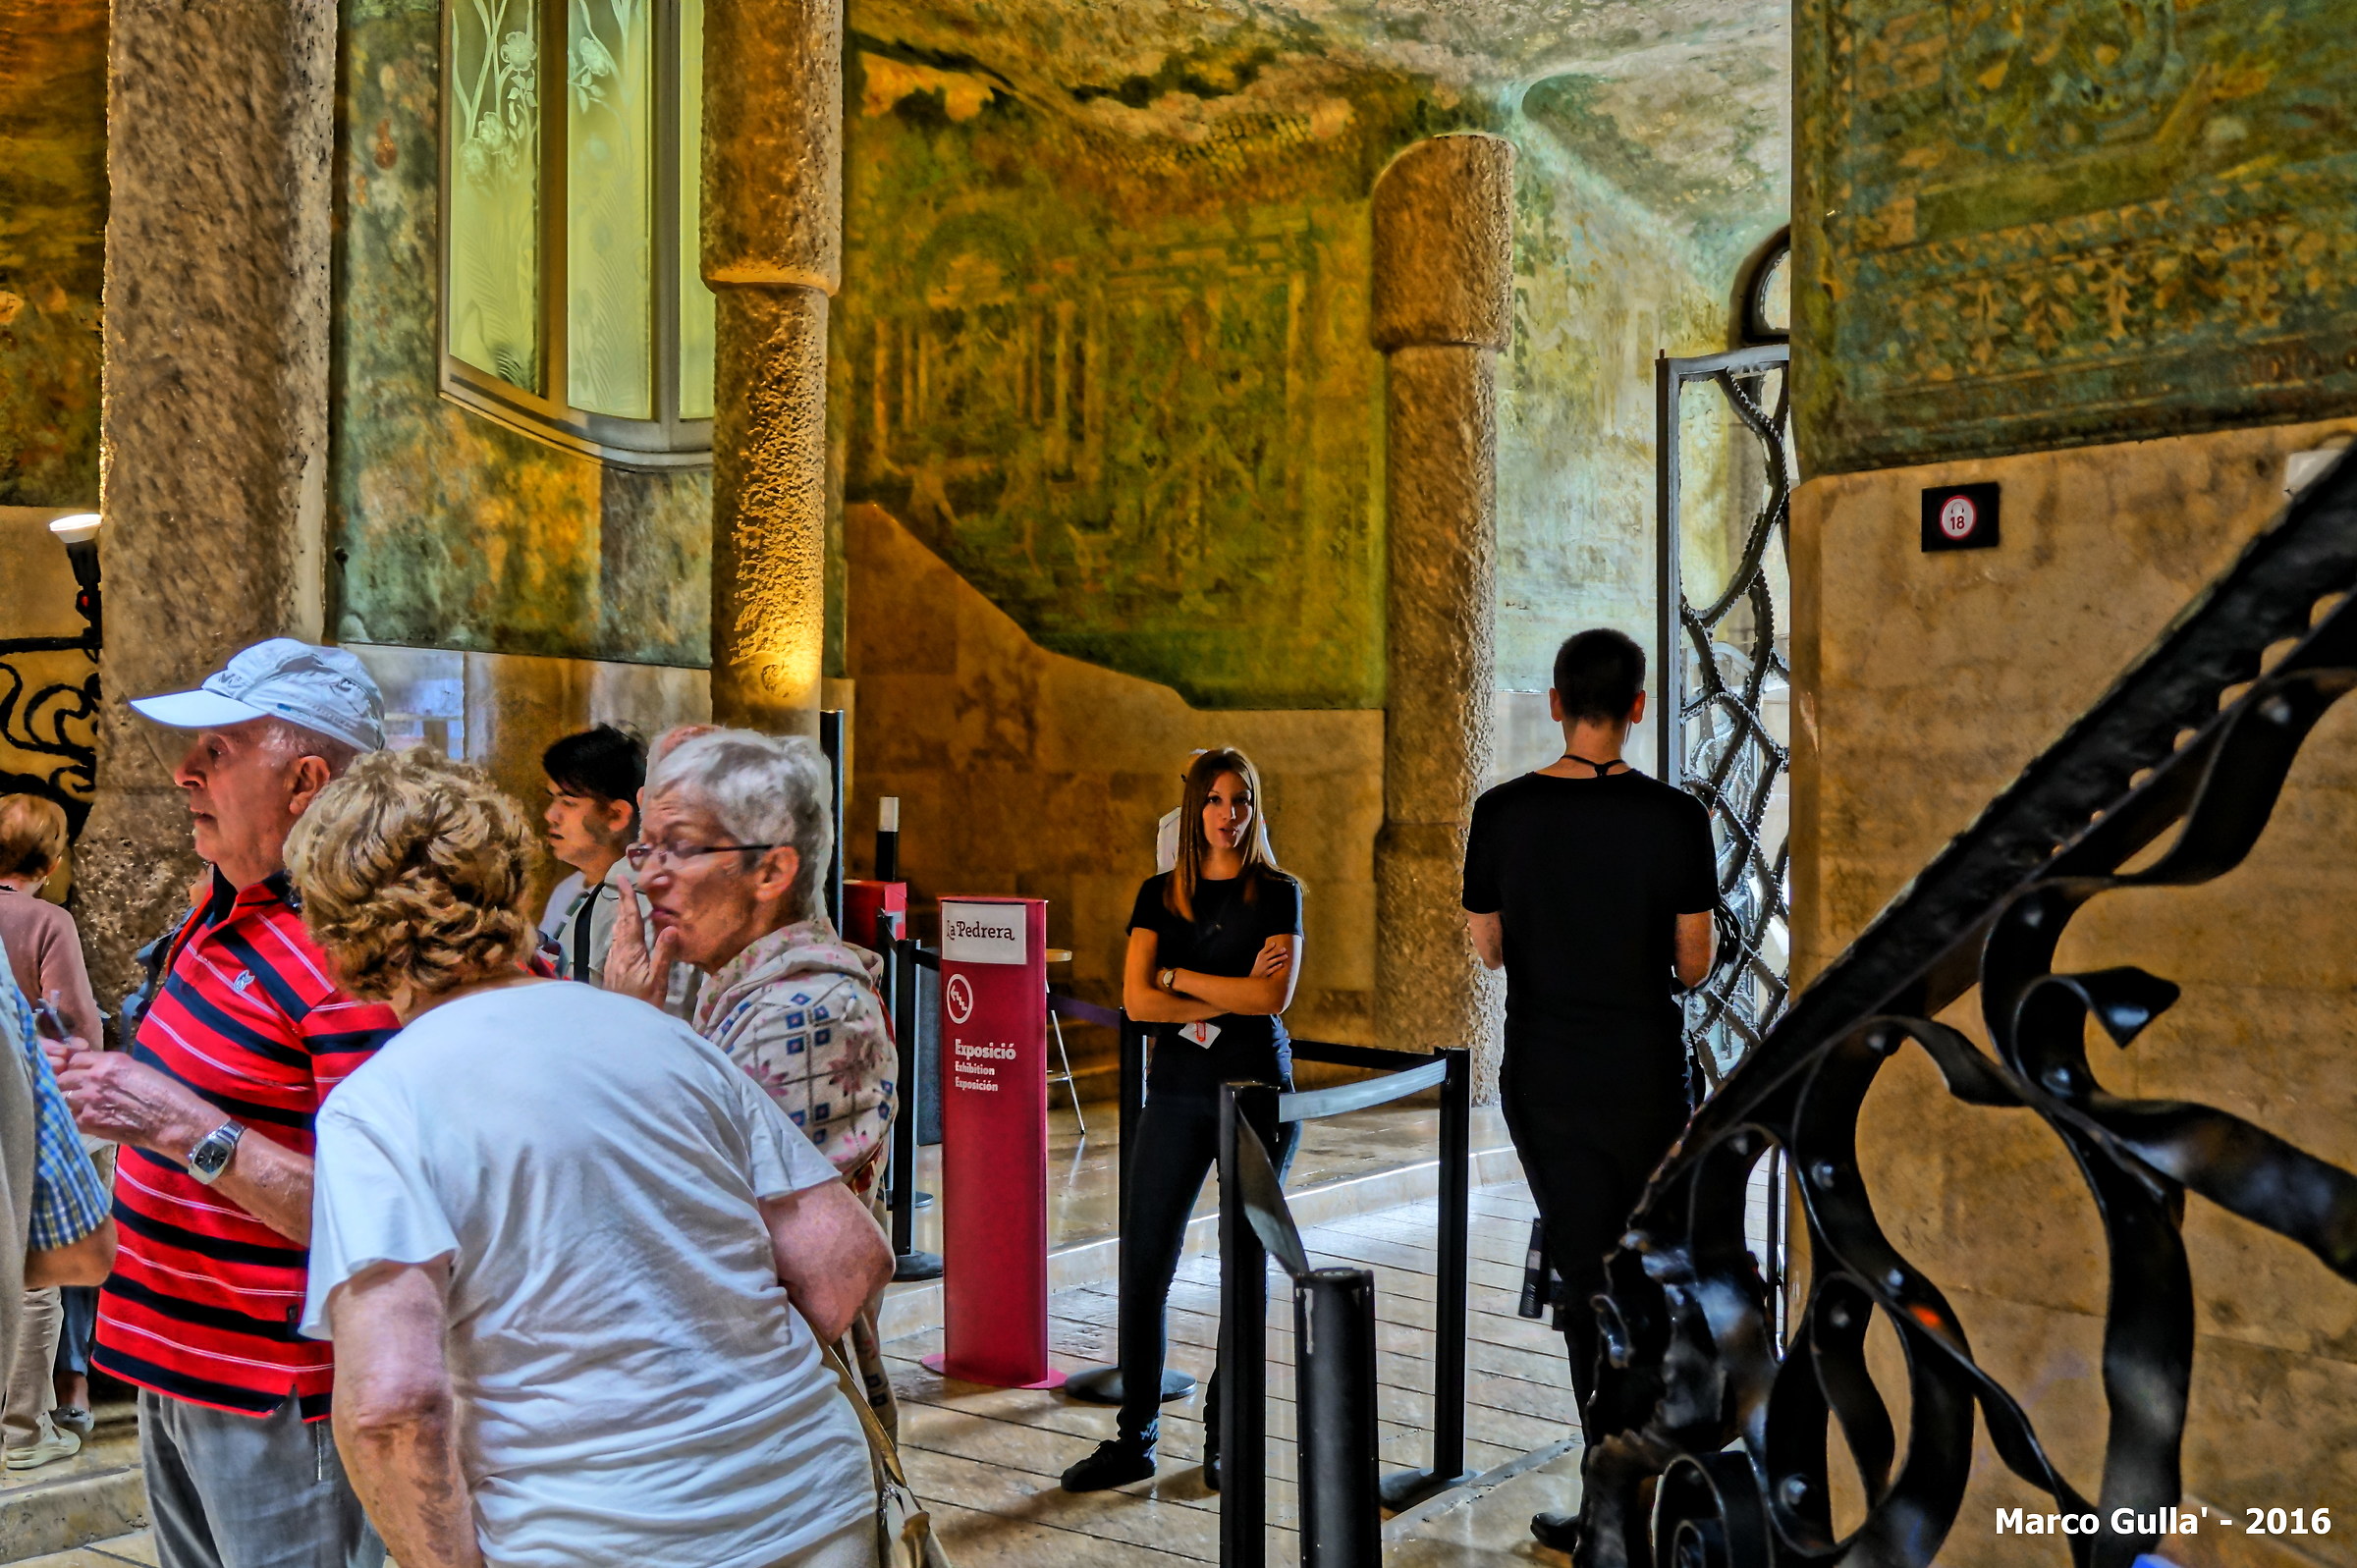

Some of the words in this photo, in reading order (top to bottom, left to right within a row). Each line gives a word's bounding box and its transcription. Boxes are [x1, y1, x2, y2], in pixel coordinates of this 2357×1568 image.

[1950, 515, 1965, 530] 18
[957, 920, 1015, 942] Pedrera
[955, 1038, 1016, 1060] Exposició
[955, 1060, 995, 1076] Exhibition
[955, 1076, 999, 1092] Exposición
